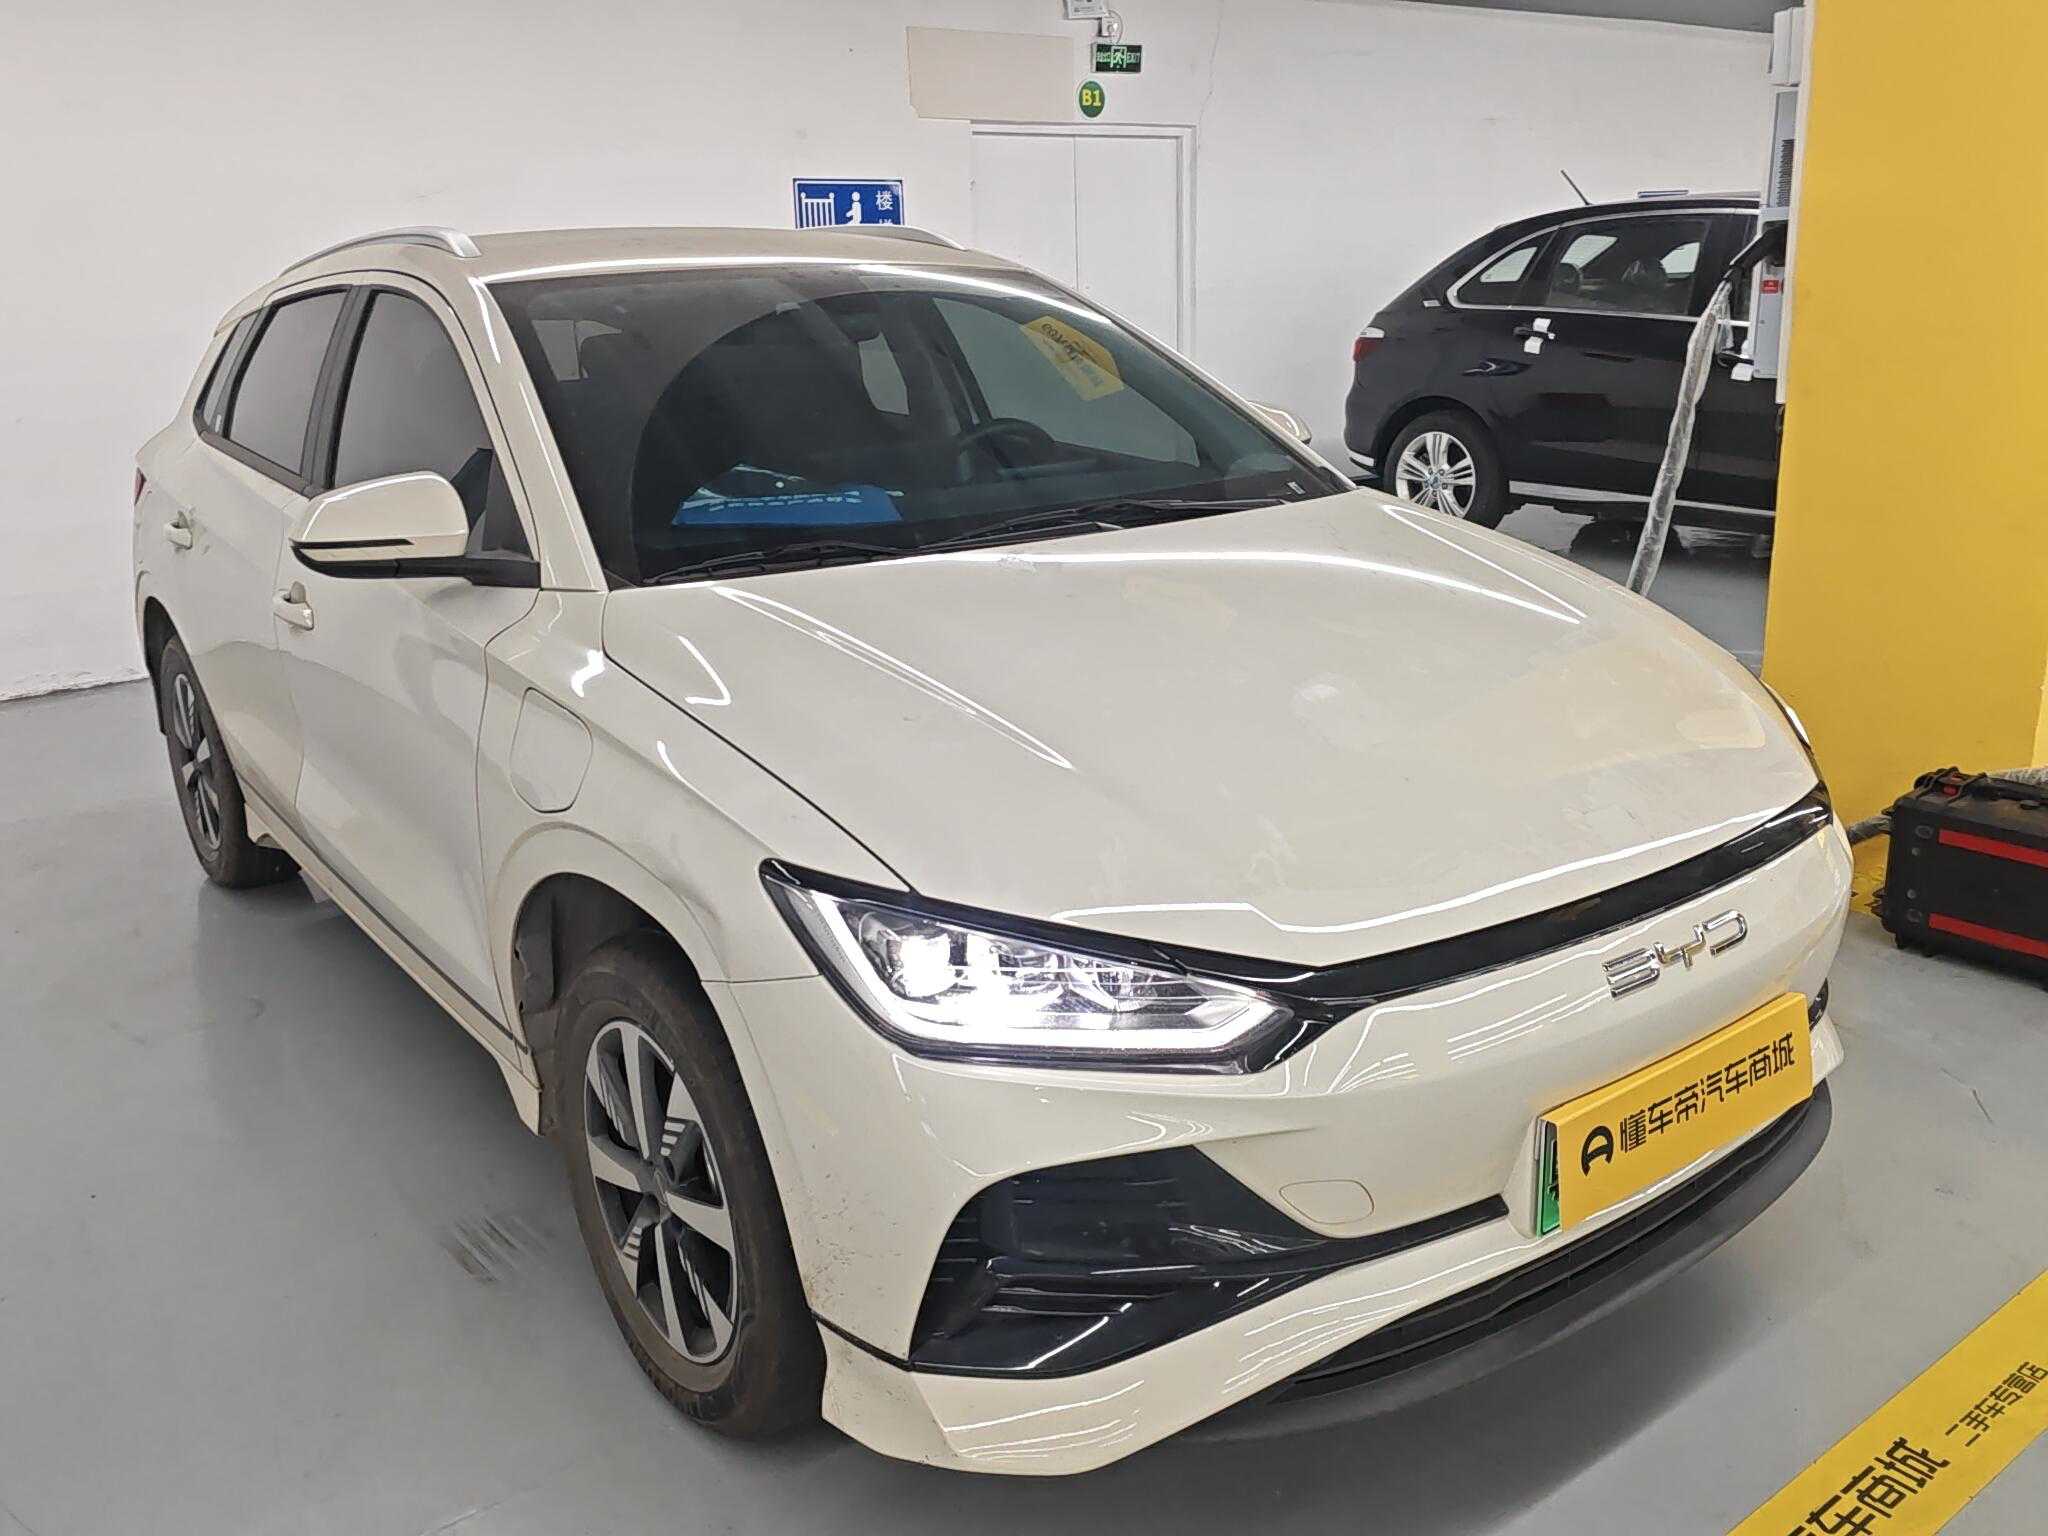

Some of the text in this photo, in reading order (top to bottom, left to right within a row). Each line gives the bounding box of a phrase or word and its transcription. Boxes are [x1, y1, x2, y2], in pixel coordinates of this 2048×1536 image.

[1082, 89, 1101, 106] B1
[875, 190, 895, 225] 楼
[1602, 909, 1748, 998] BYD
[1619, 1031, 1796, 1154] 懂车帝汽车商城
[1787, 1361, 2048, 1536] 车商城 二手车专营店
